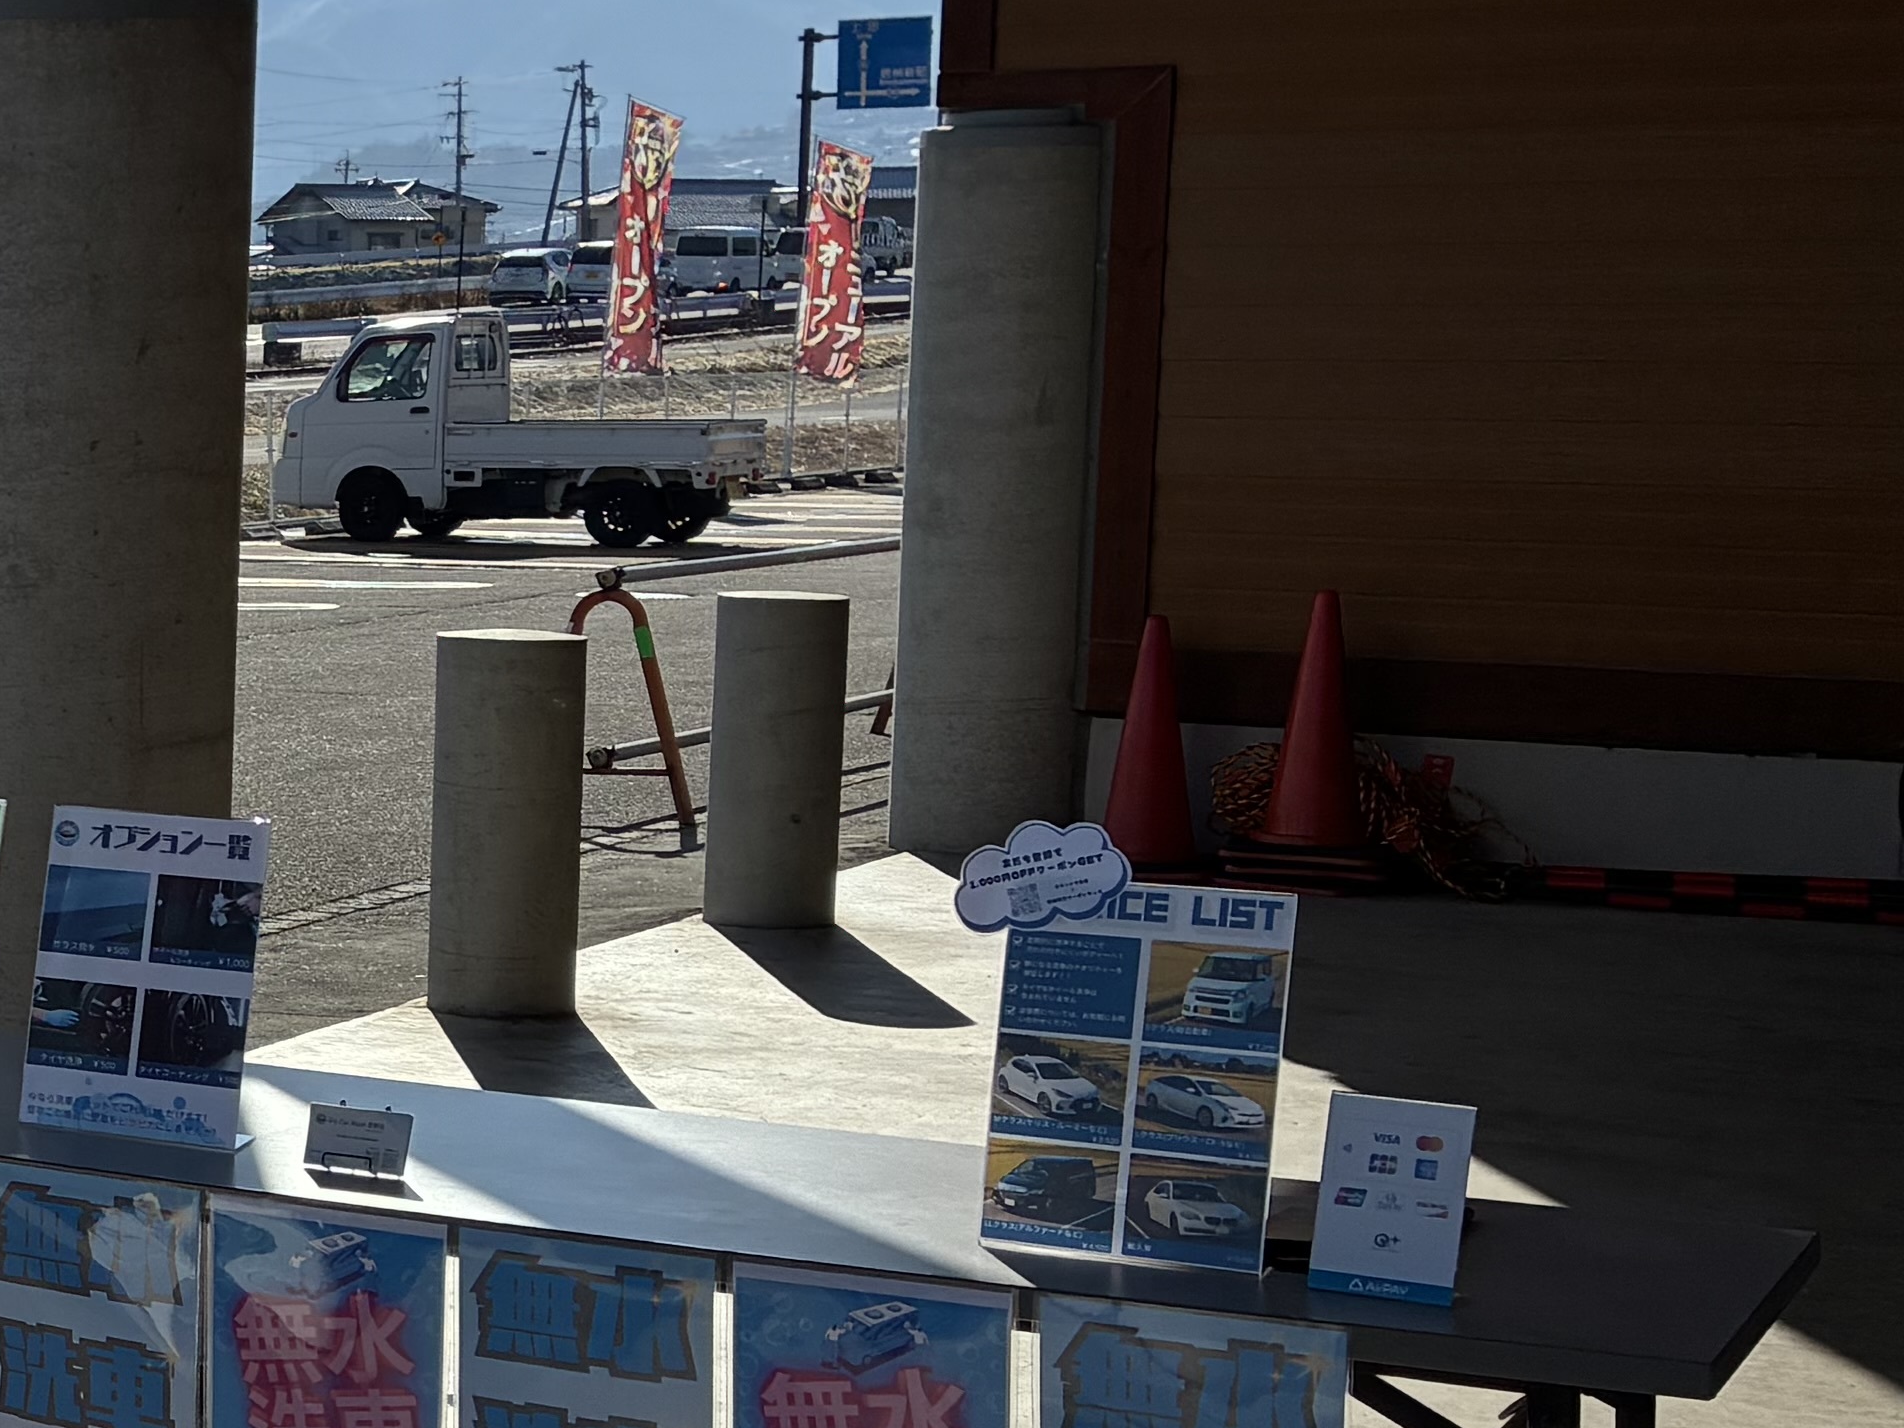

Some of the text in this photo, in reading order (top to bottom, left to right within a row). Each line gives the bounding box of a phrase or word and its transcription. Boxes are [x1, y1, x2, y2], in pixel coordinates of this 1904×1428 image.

[619, 212, 650, 334] オープン
[804, 239, 844, 347] オープン
[89, 823, 253, 861] オプション一覧
[1096, 889, 1171, 924] ICE
[1190, 895, 1286, 931] LIST
[1373, 1132, 1401, 1146] VISA
[233, 1289, 416, 1385] 無水
[469, 1249, 697, 1383] 無水
